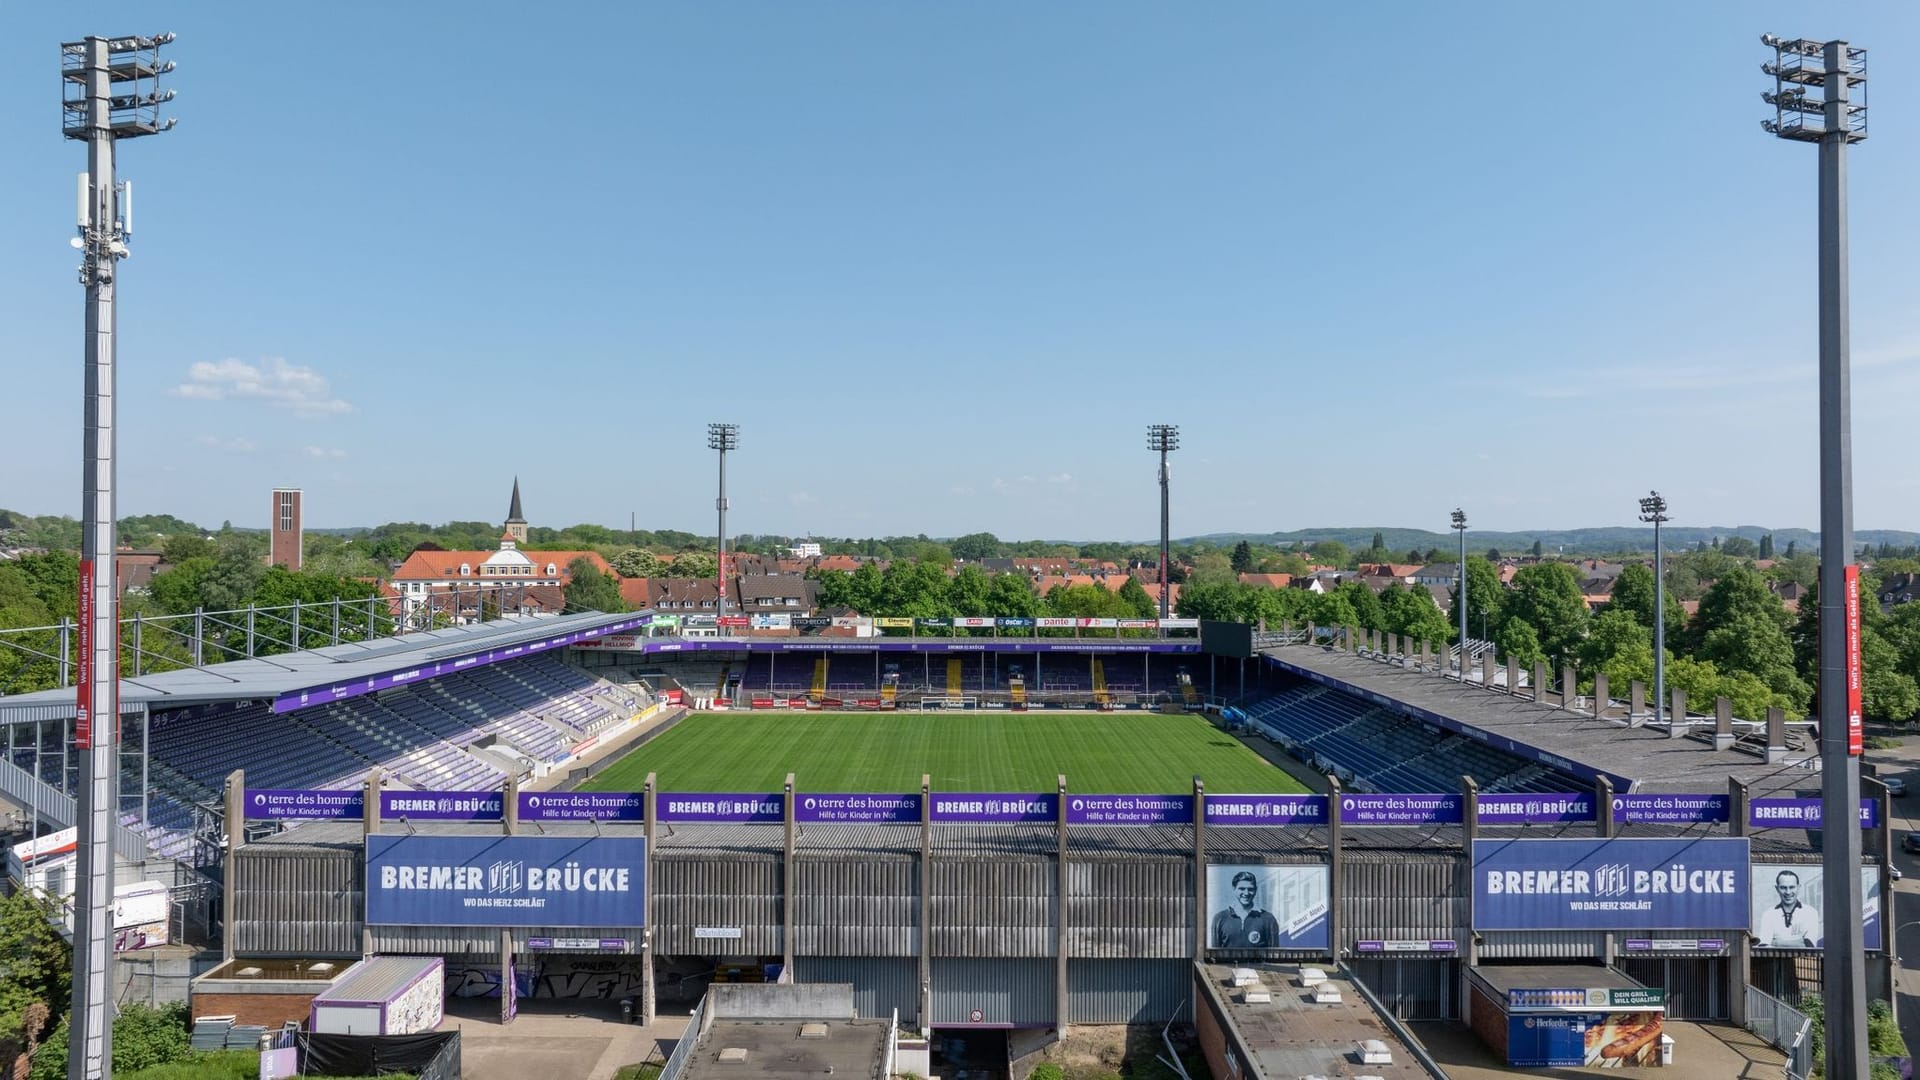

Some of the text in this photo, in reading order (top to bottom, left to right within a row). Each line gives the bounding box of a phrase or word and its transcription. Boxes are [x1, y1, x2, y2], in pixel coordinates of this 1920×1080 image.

[268, 794, 364, 805] terre des hommes
[390, 801, 436, 812] BREMER
[455, 797, 500, 812] BRÜCKE
[542, 796, 639, 807] terre des hommes
[818, 797, 915, 809] terre des hommes
[1086, 797, 1184, 809] terre des hommes
[1357, 797, 1454, 809] terre des hommes
[1625, 798, 1723, 809] terre des hommes
[668, 802, 715, 813] BREMER
[734, 799, 779, 813] BRÜCKE
[936, 802, 983, 813] BREMER
[1002, 799, 1048, 814] BRÜCKE
[1207, 803, 1253, 815] BREMER
[1273, 801, 1319, 815] BRÜCKE
[1477, 803, 1524, 814] BREMER
[1543, 800, 1588, 814] BRÜCKE
[268, 808, 345, 816] Hilfe für Kinder in Not
[542, 809, 559, 817] Hilfe
[560, 809, 572, 817] für
[573, 809, 597, 818] Kinder
[607, 810, 620, 818] Not
[818, 810, 896, 819] Hilfe für Kinder in Not
[1086, 812, 1165, 820] Hilfe für Kinder in Not
[1357, 811, 1436, 820] Hilfe für Kinder in Not
[1625, 811, 1703, 820] Hilfe für Kinder in Not
[1755, 807, 1803, 819] BREMER
[381, 866, 483, 890] BREMER
[527, 862, 629, 892] BRÜCKE
[1487, 870, 1589, 894] BREMER
[1633, 864, 1735, 894] BRÜCKE
[464, 897, 546, 908] WO DAS HERZ SCHLÄGT
[1570, 900, 1652, 911] WO DAS HERZ SCHLÄGT
[1630, 995, 1661, 1004] QUALITÄT
[1536, 1018, 1568, 1028] Herforder
